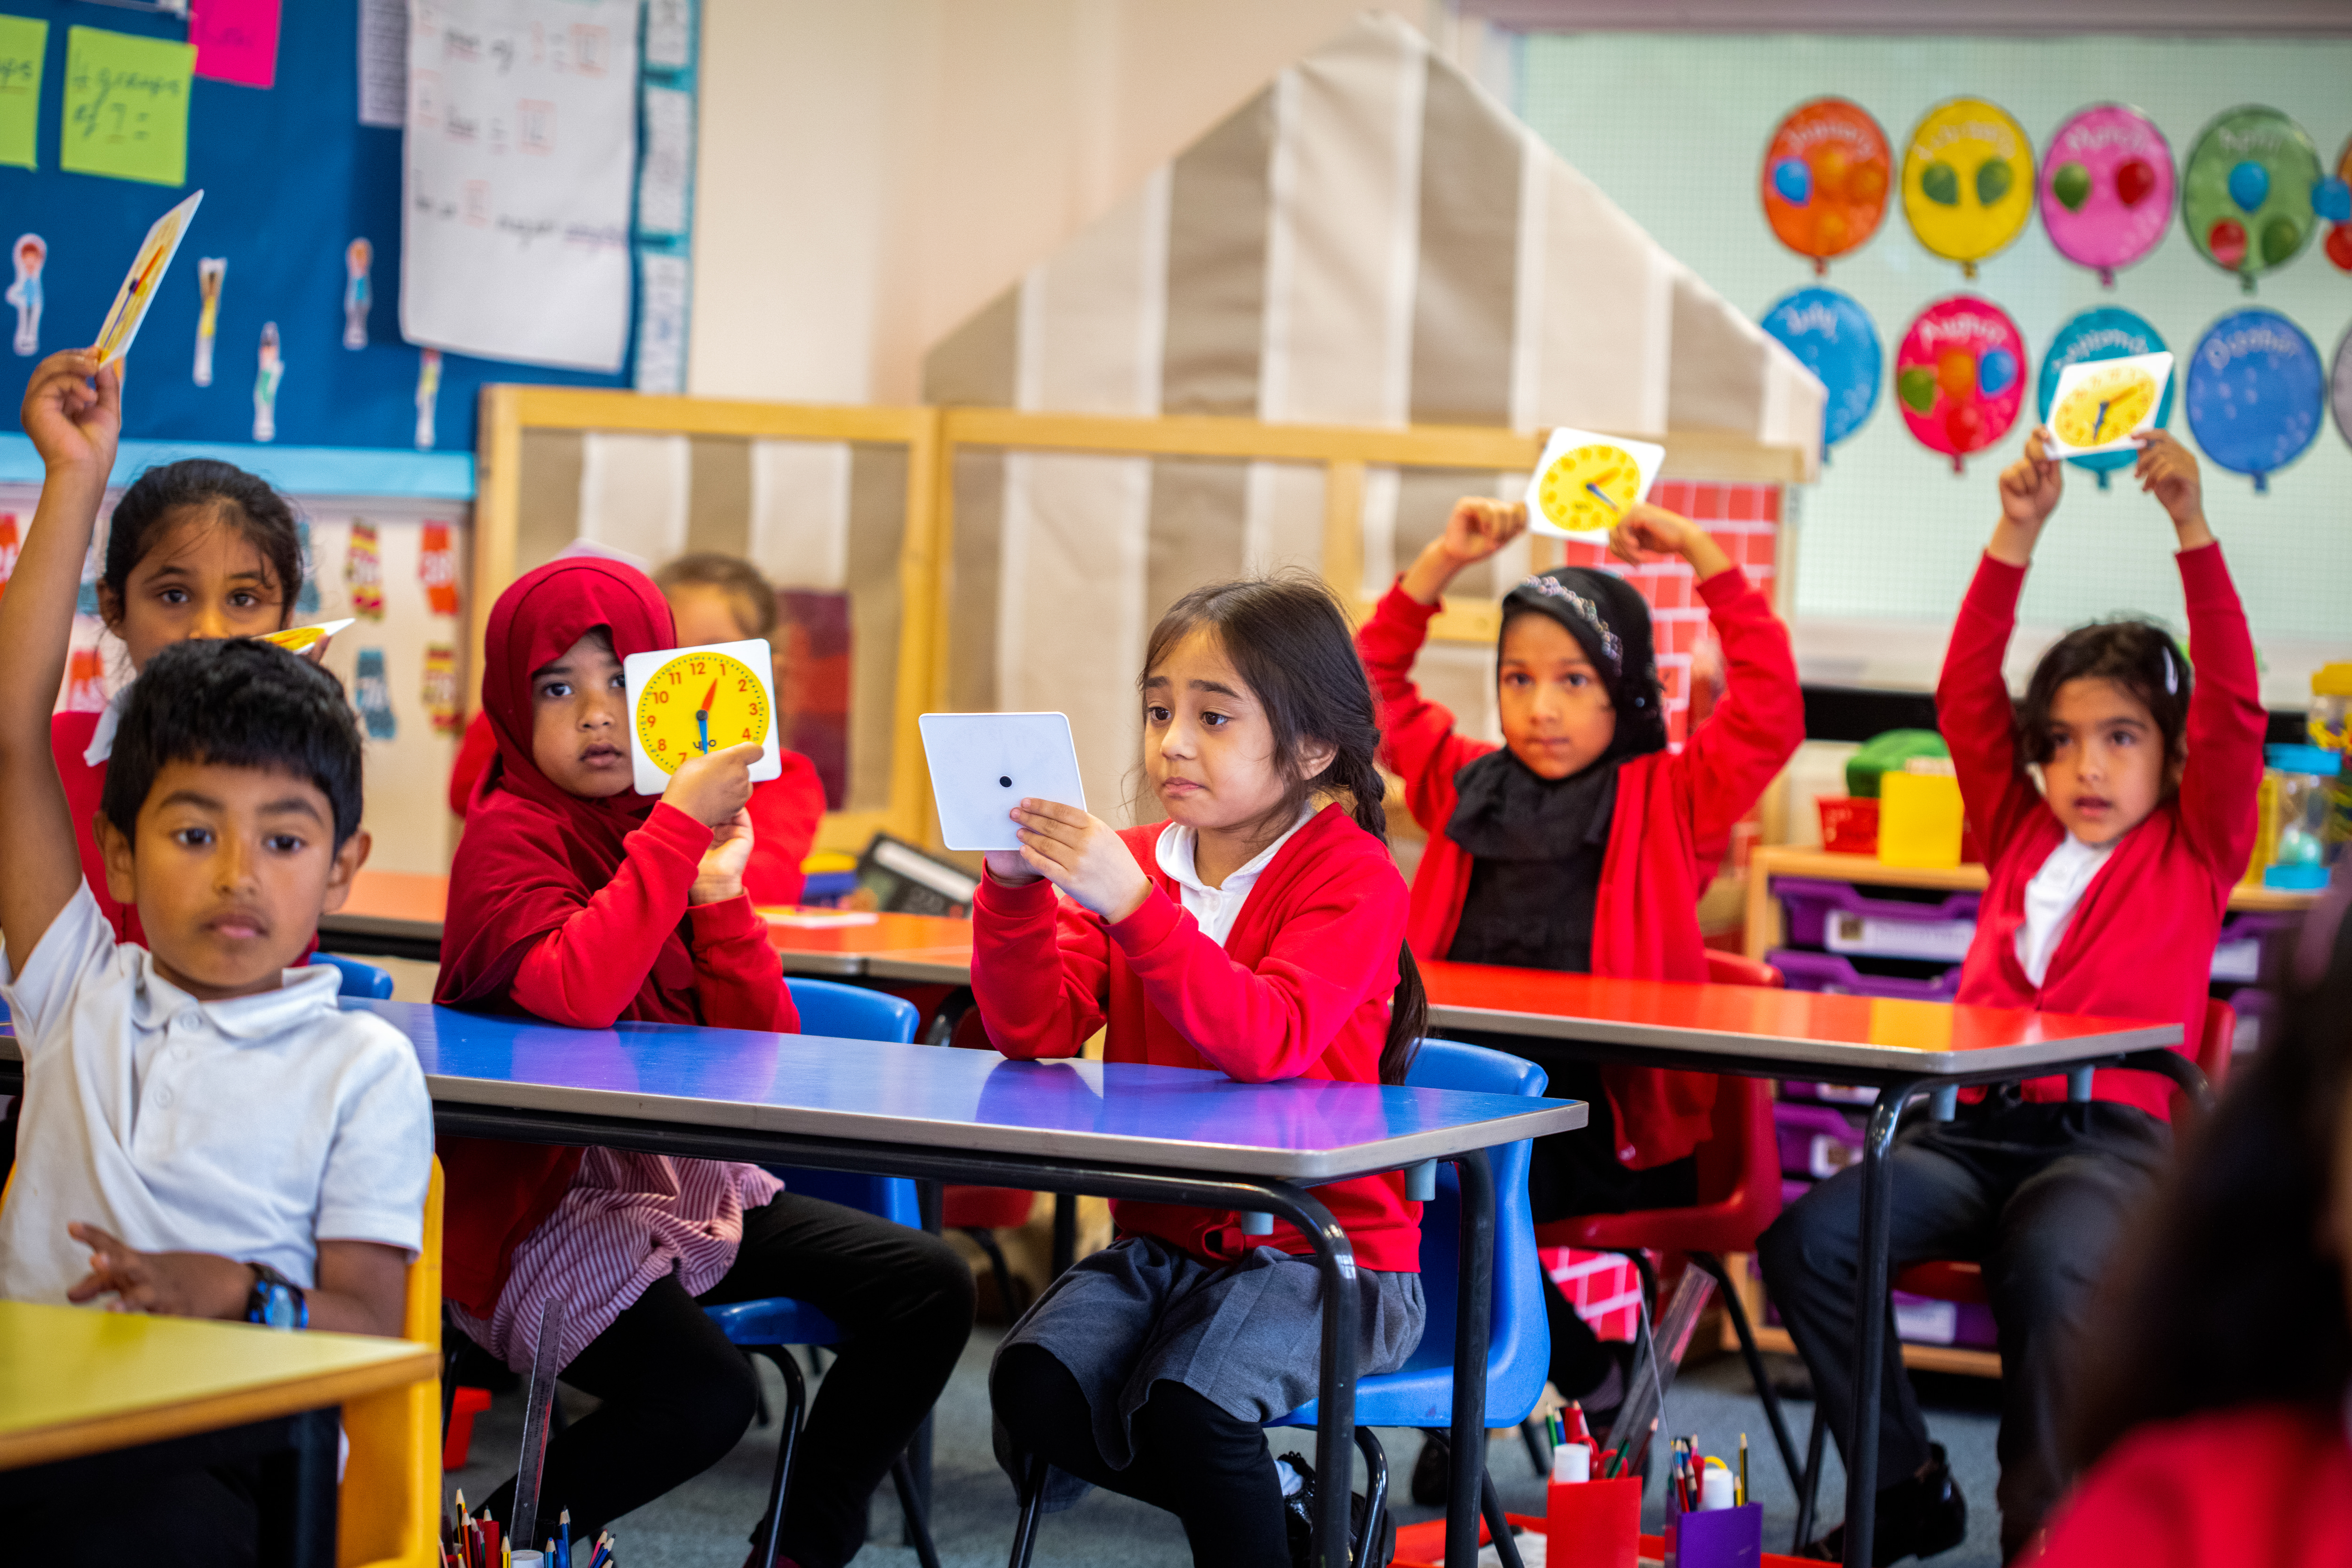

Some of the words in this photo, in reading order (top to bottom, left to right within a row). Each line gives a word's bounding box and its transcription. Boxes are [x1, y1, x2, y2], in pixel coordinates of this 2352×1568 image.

[690, 661, 706, 676] 12
[719, 663, 726, 676] 1
[668, 671, 682, 685] 11
[738, 678, 748, 692] 2
[652, 690, 669, 704] 10
[748, 702, 759, 716] 3
[646, 715, 656, 728] 9
[741, 727, 752, 740] 4
[657, 738, 667, 752] 8
[678, 751, 688, 764] 7
